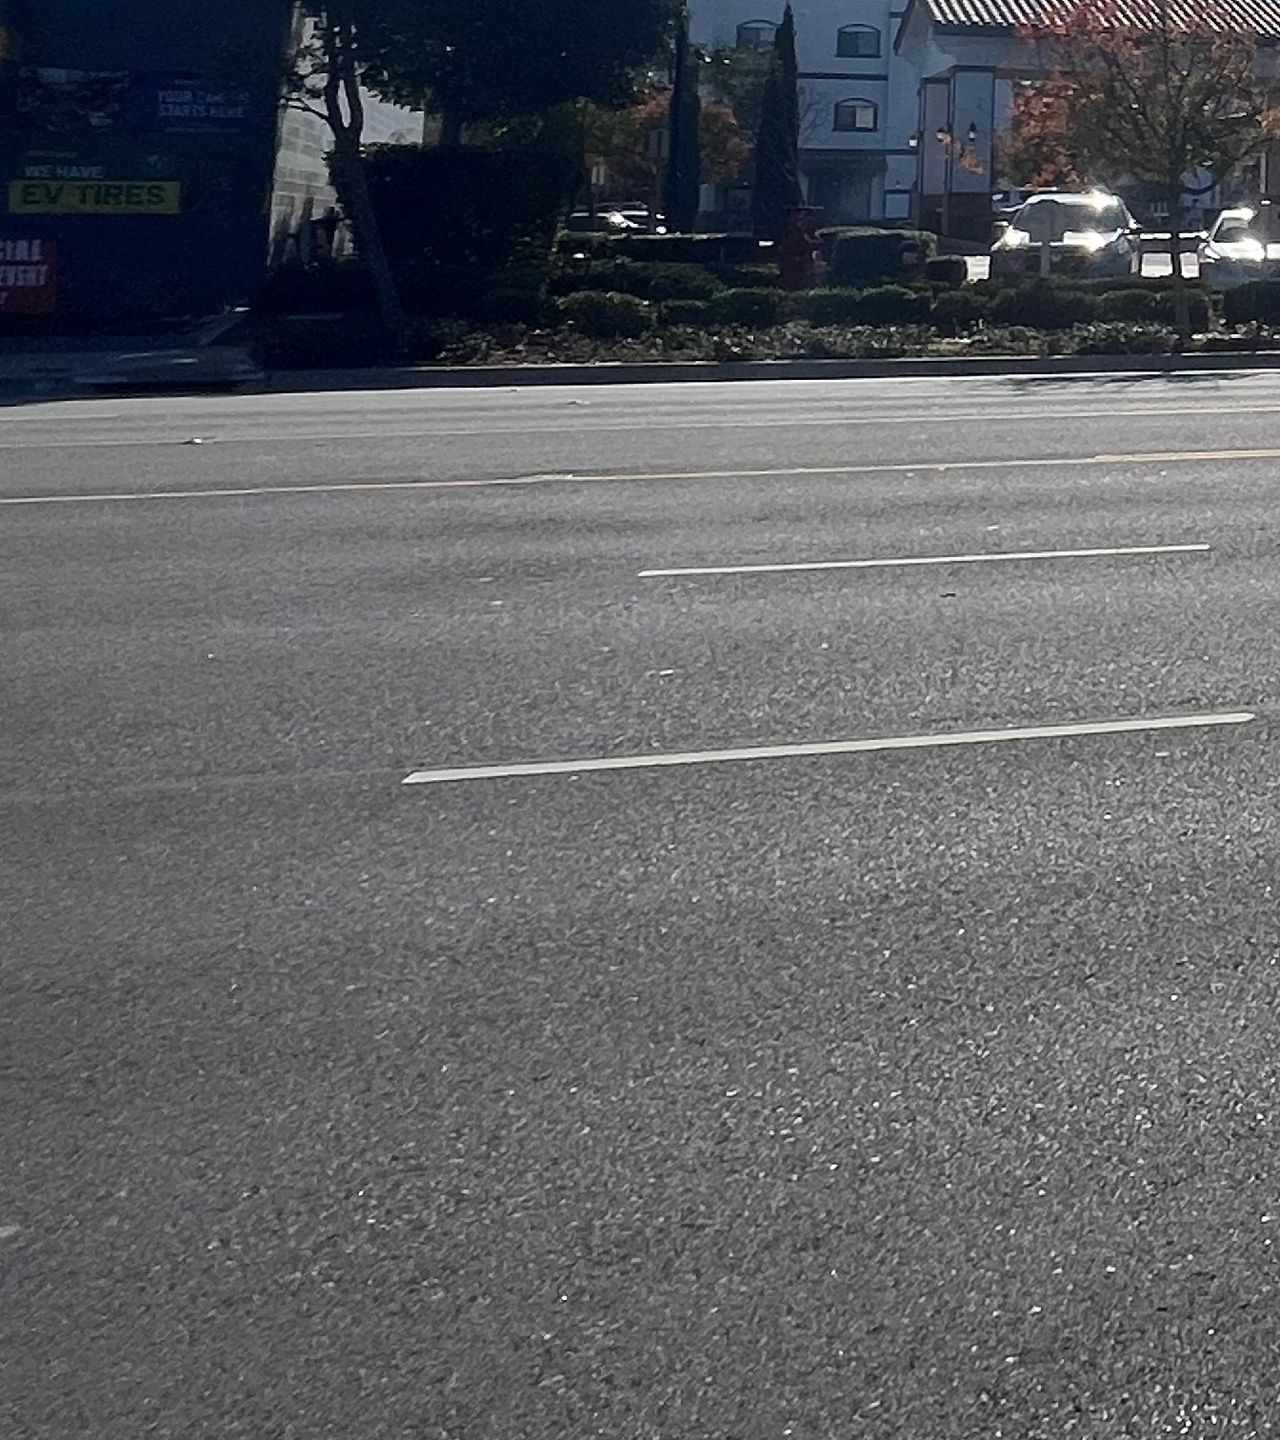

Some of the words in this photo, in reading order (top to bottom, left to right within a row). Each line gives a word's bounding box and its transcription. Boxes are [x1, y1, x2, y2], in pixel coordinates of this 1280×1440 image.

[25, 165, 52, 178] WE
[55, 165, 104, 179] HAVE
[20, 184, 64, 206] EV
[77, 184, 166, 207] TIRES
